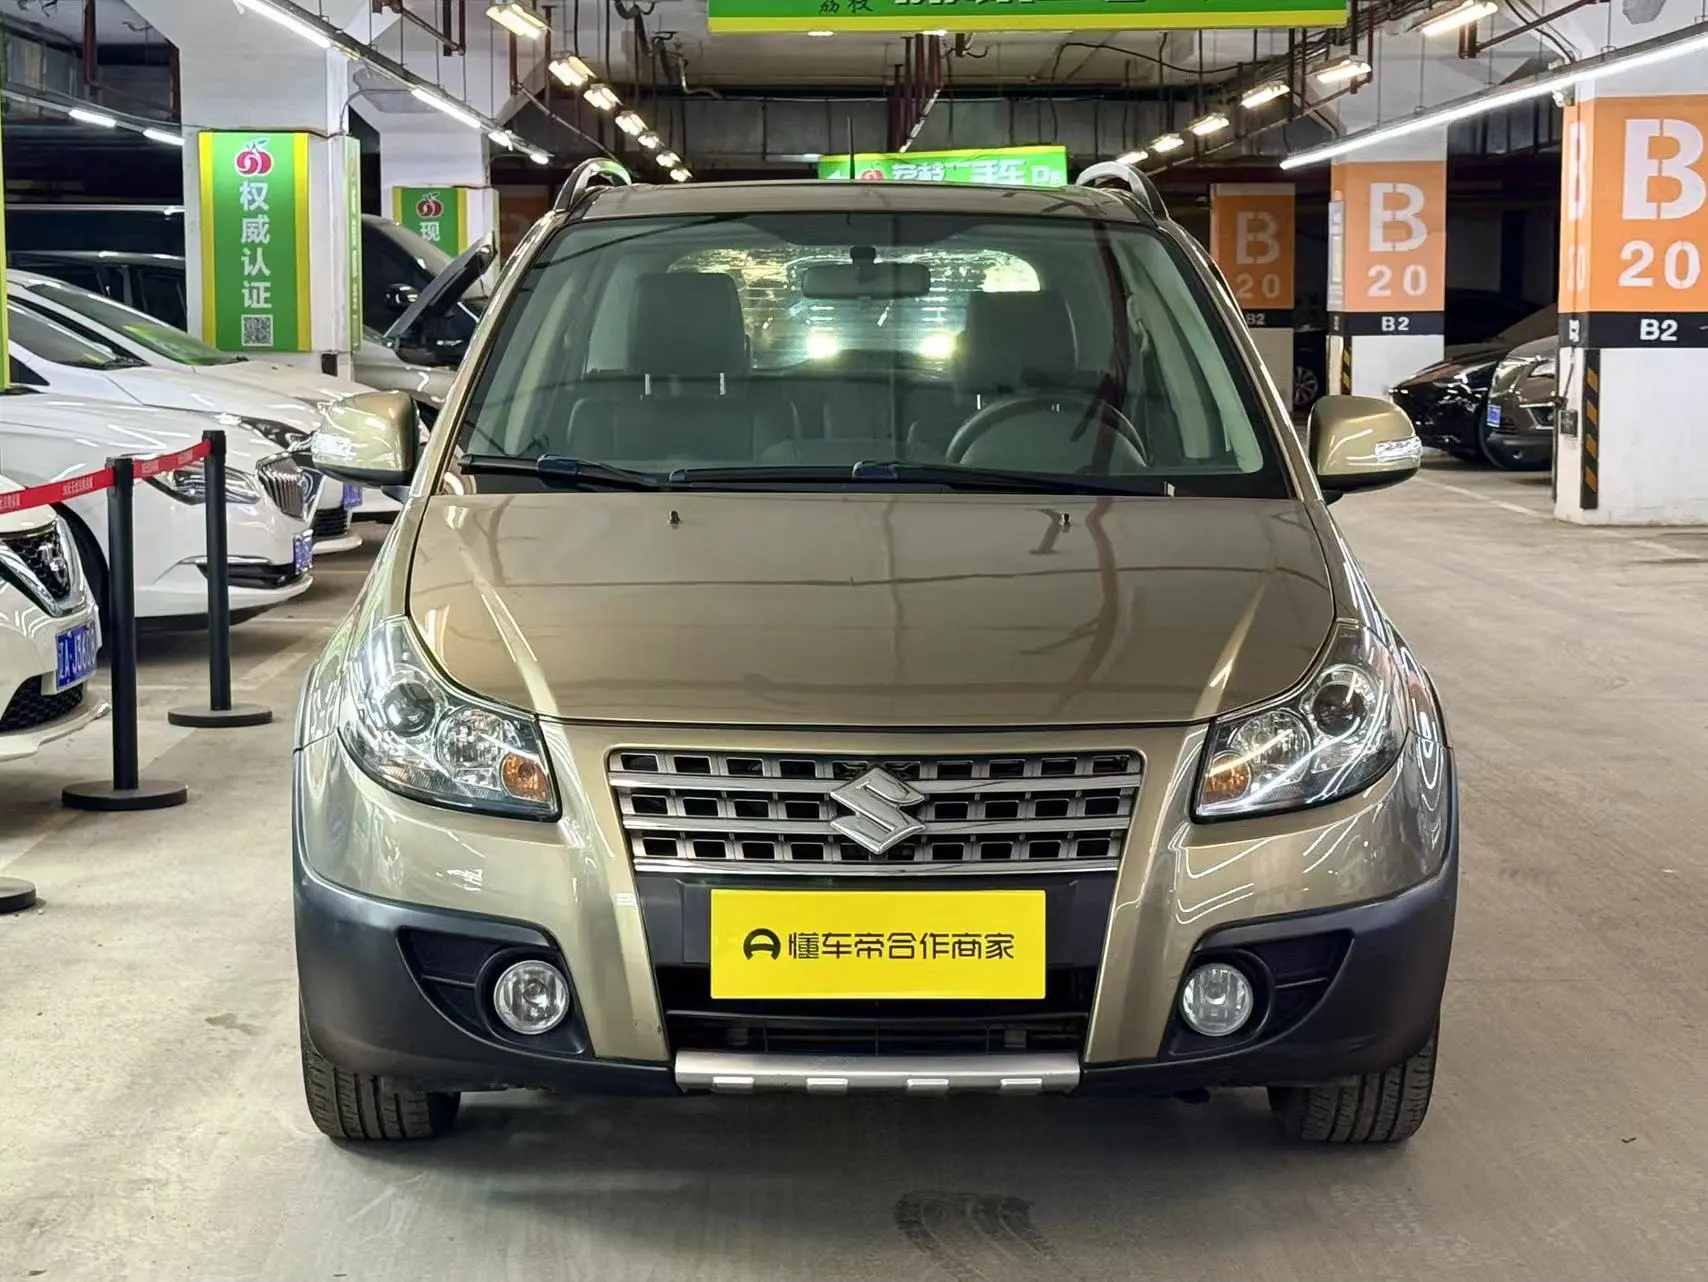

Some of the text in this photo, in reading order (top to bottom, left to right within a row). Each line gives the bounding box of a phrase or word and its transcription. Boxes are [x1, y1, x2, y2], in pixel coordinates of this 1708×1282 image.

[1622, 119, 1706, 219] B
[1369, 182, 1428, 252] B
[239, 181, 272, 309] 权威认证
[1237, 212, 1280, 264] B
[1367, 264, 1427, 297] 20
[1618, 240, 1701, 289] 20
[1236, 273, 1280, 299] 20
[1381, 316, 1410, 332] B2
[1640, 319, 1678, 341] B2
[788, 932, 1014, 960] 懂车帝合作商家
